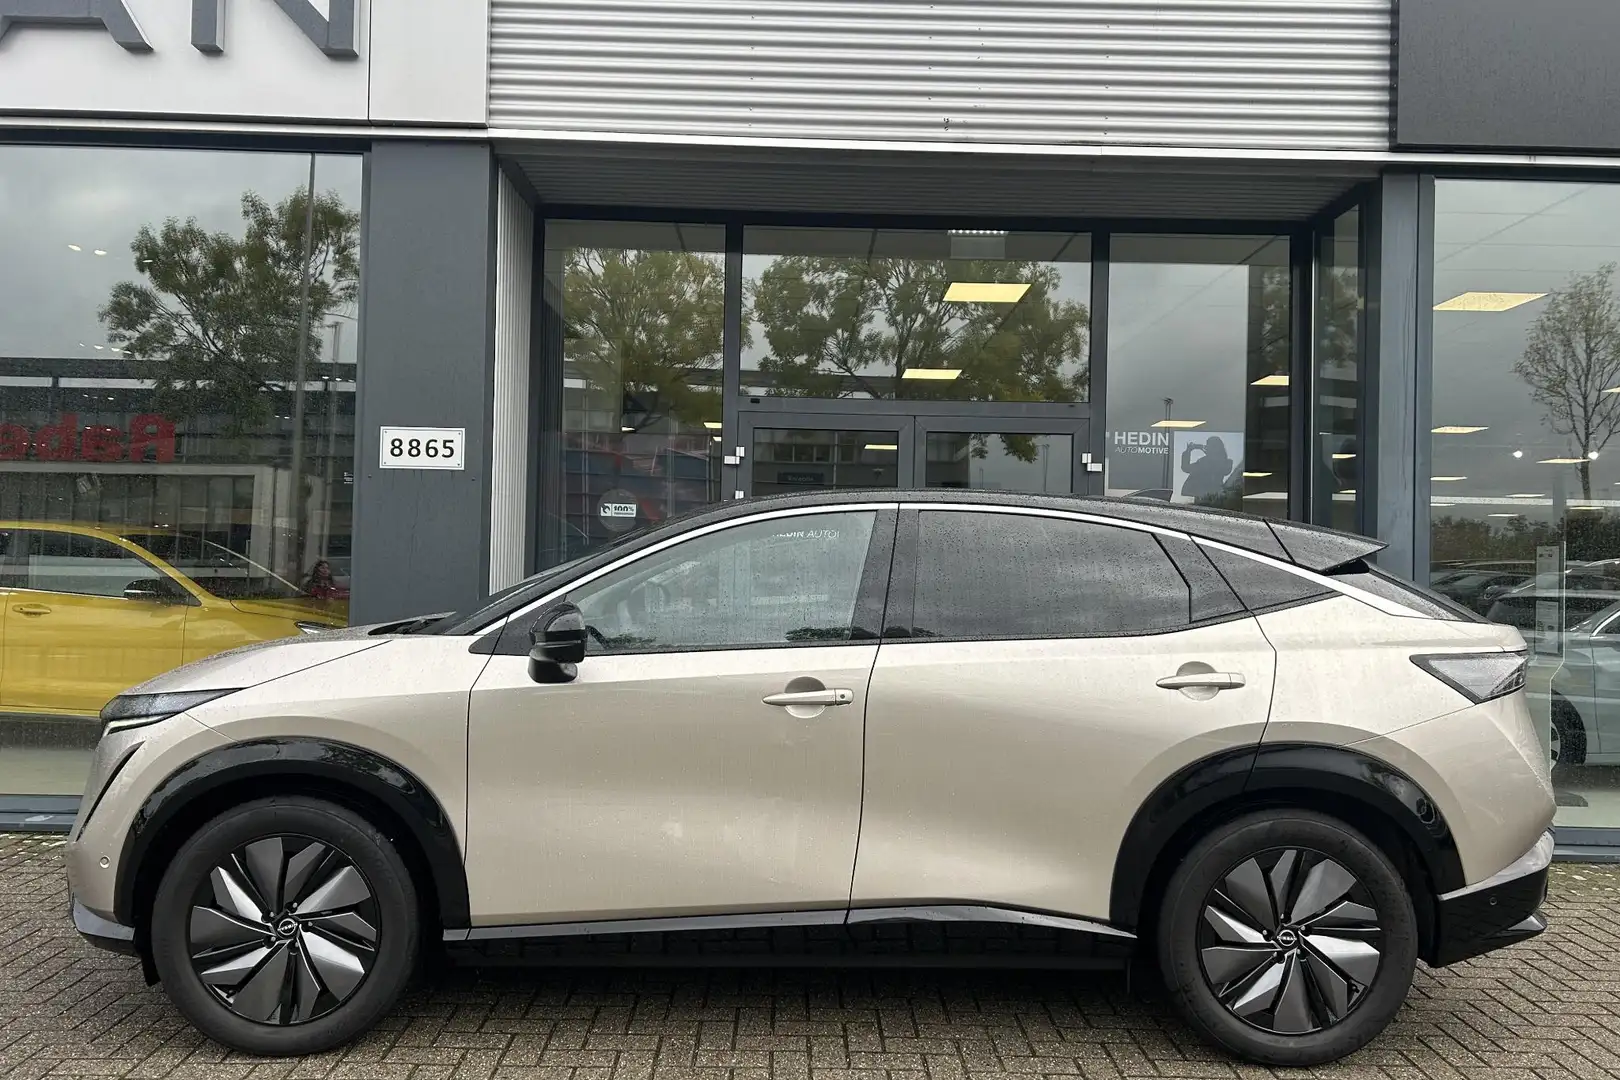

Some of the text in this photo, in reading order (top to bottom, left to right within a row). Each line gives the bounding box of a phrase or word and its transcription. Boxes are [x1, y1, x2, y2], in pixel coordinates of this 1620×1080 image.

[1114, 431, 1169, 446] HEDIN
[390, 438, 455, 458] 8865
[1115, 446, 1169, 455] AUTOMOTIVE
